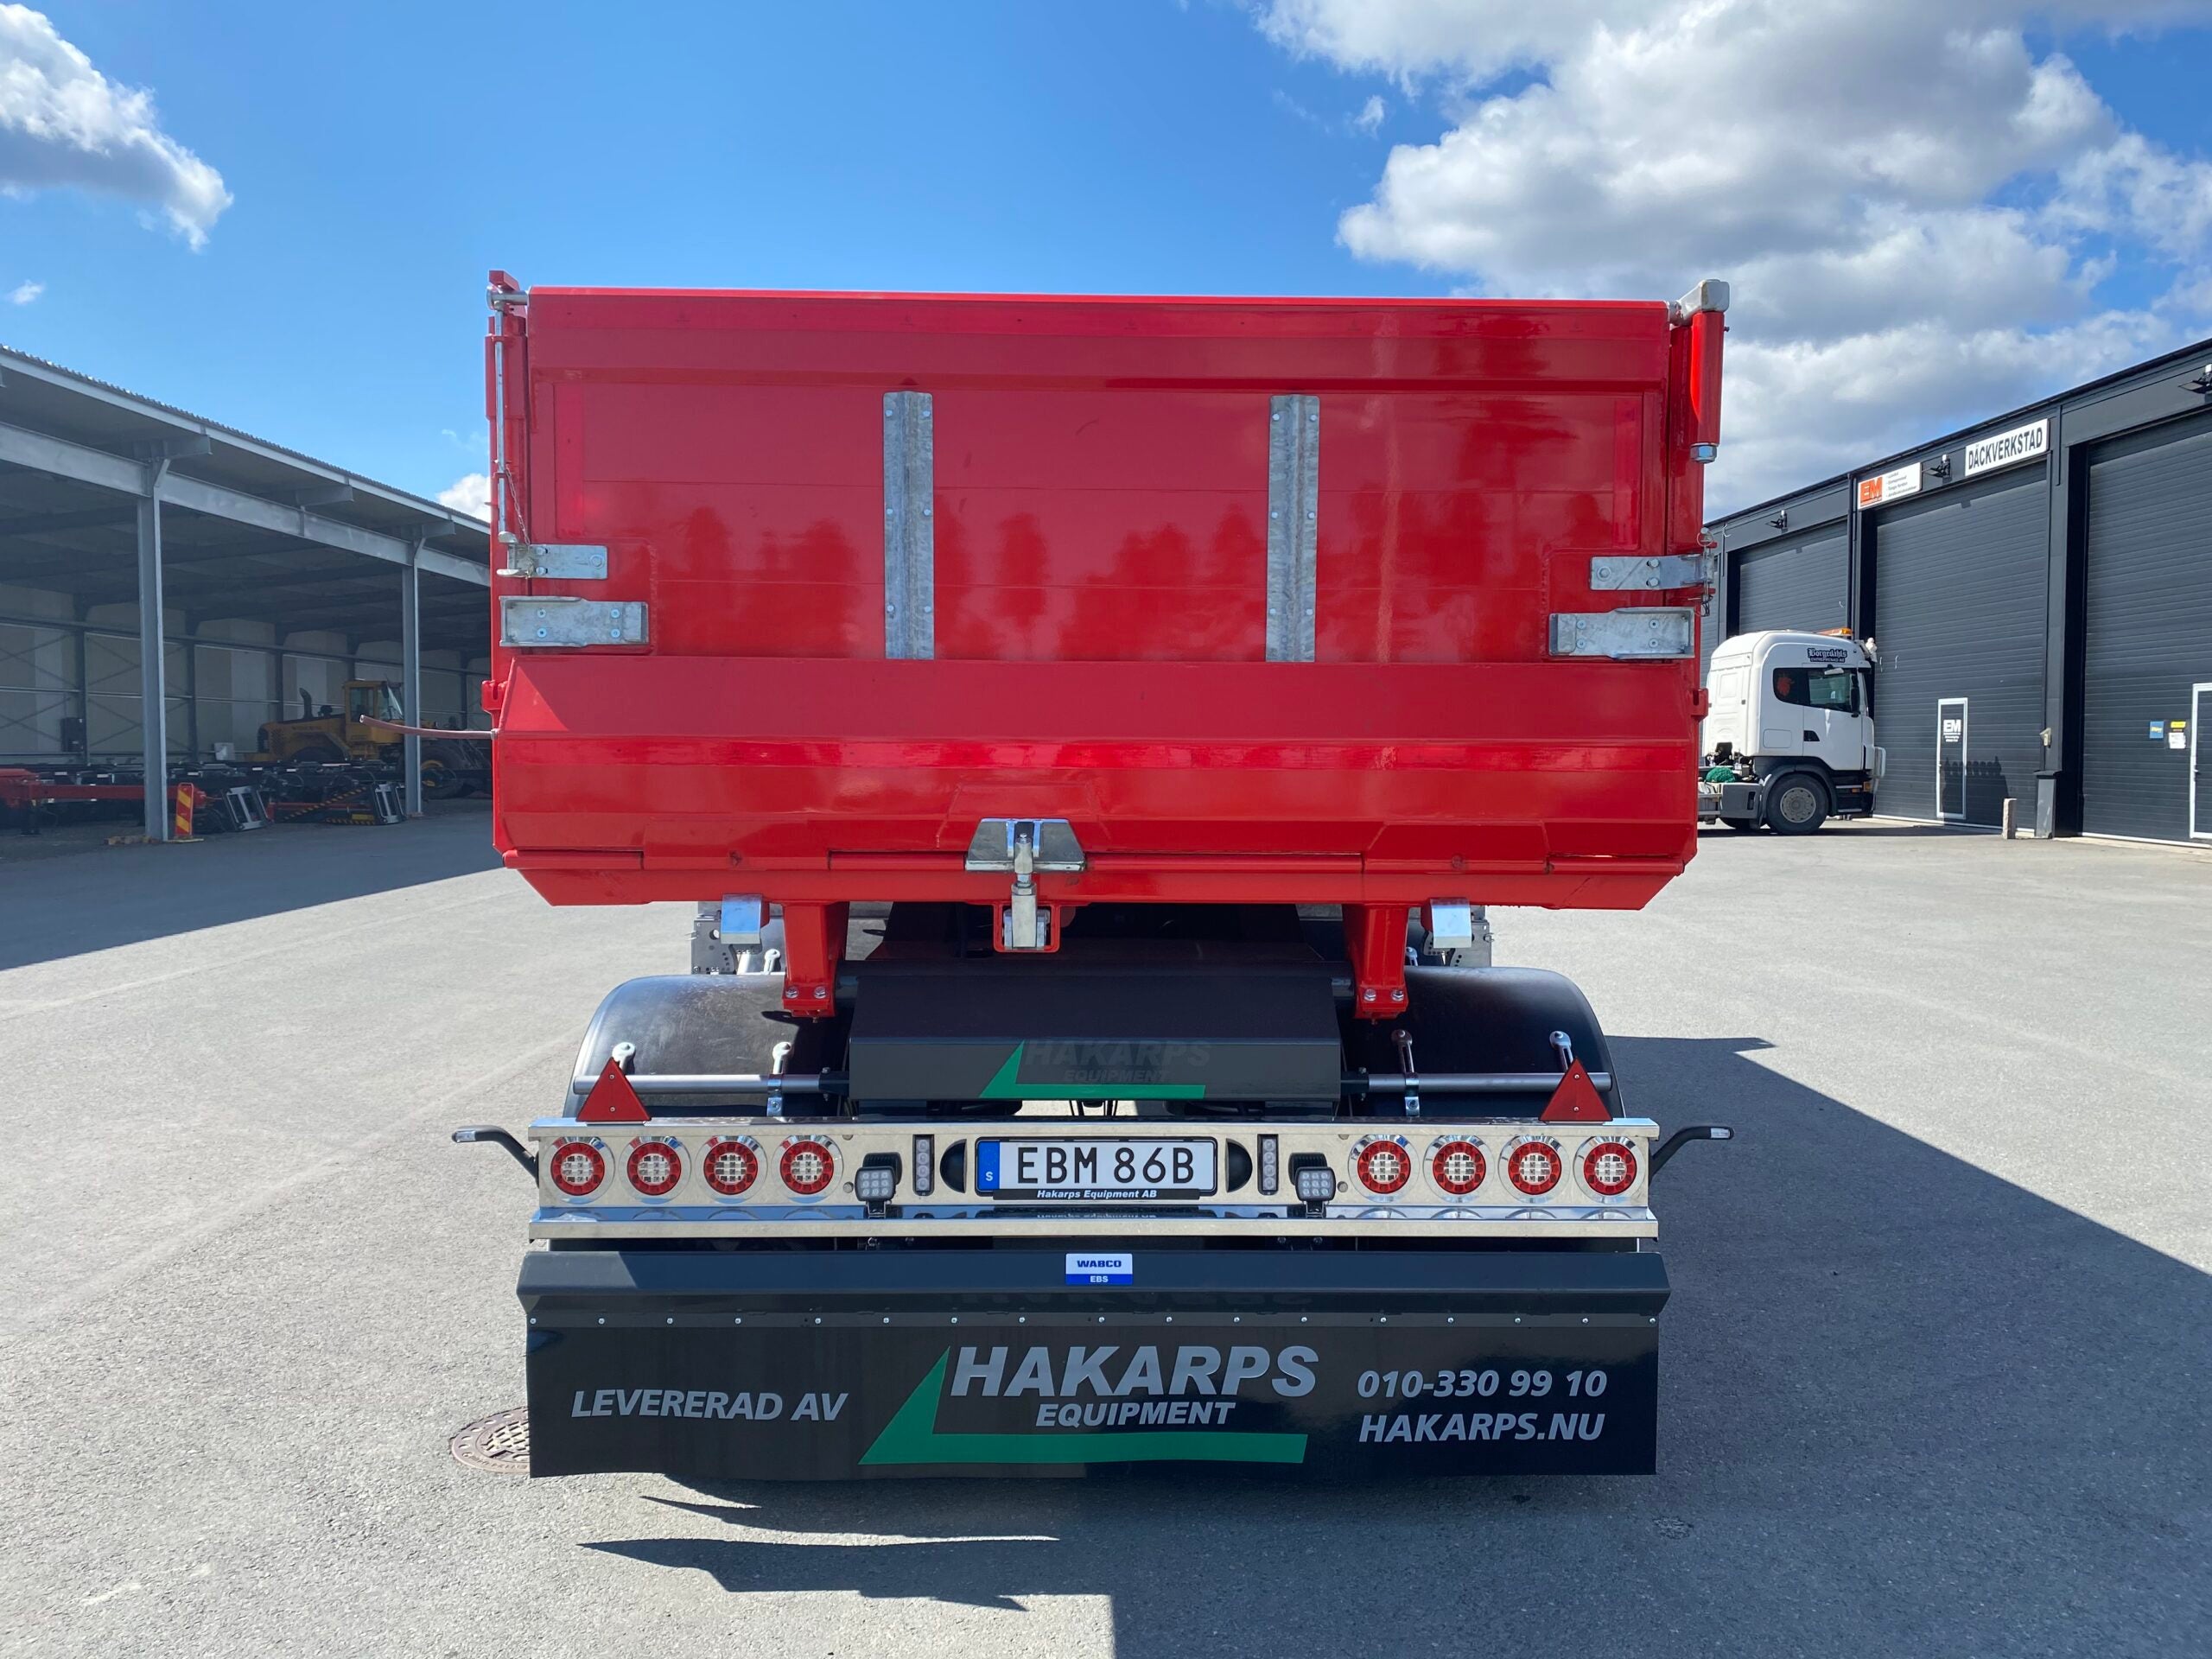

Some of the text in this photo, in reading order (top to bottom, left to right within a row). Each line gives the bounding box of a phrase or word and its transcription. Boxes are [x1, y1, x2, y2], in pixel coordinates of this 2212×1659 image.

[1967, 427, 2044, 470] DÄCKVERKSTAD
[1859, 476, 1883, 503] EM
[1943, 719, 1961, 733] EM
[1025, 1040, 1210, 1066] HAKARPS
[1064, 1069, 1172, 1082] EQUIPMENT
[985, 1171, 994, 1182] S
[1017, 1147, 1194, 1184] EBM 86B
[1037, 1190, 1157, 1199] Hakarps Equipment AB
[950, 1345, 1319, 1397] HAKARPS
[1357, 1370, 1608, 1398] 010-330 99 10
[571, 1389, 849, 1421] LEVERERAD AV
[1035, 1402, 1236, 1428] EQUIPMENT
[1358, 1413, 1605, 1442] HAKARPS.NU
